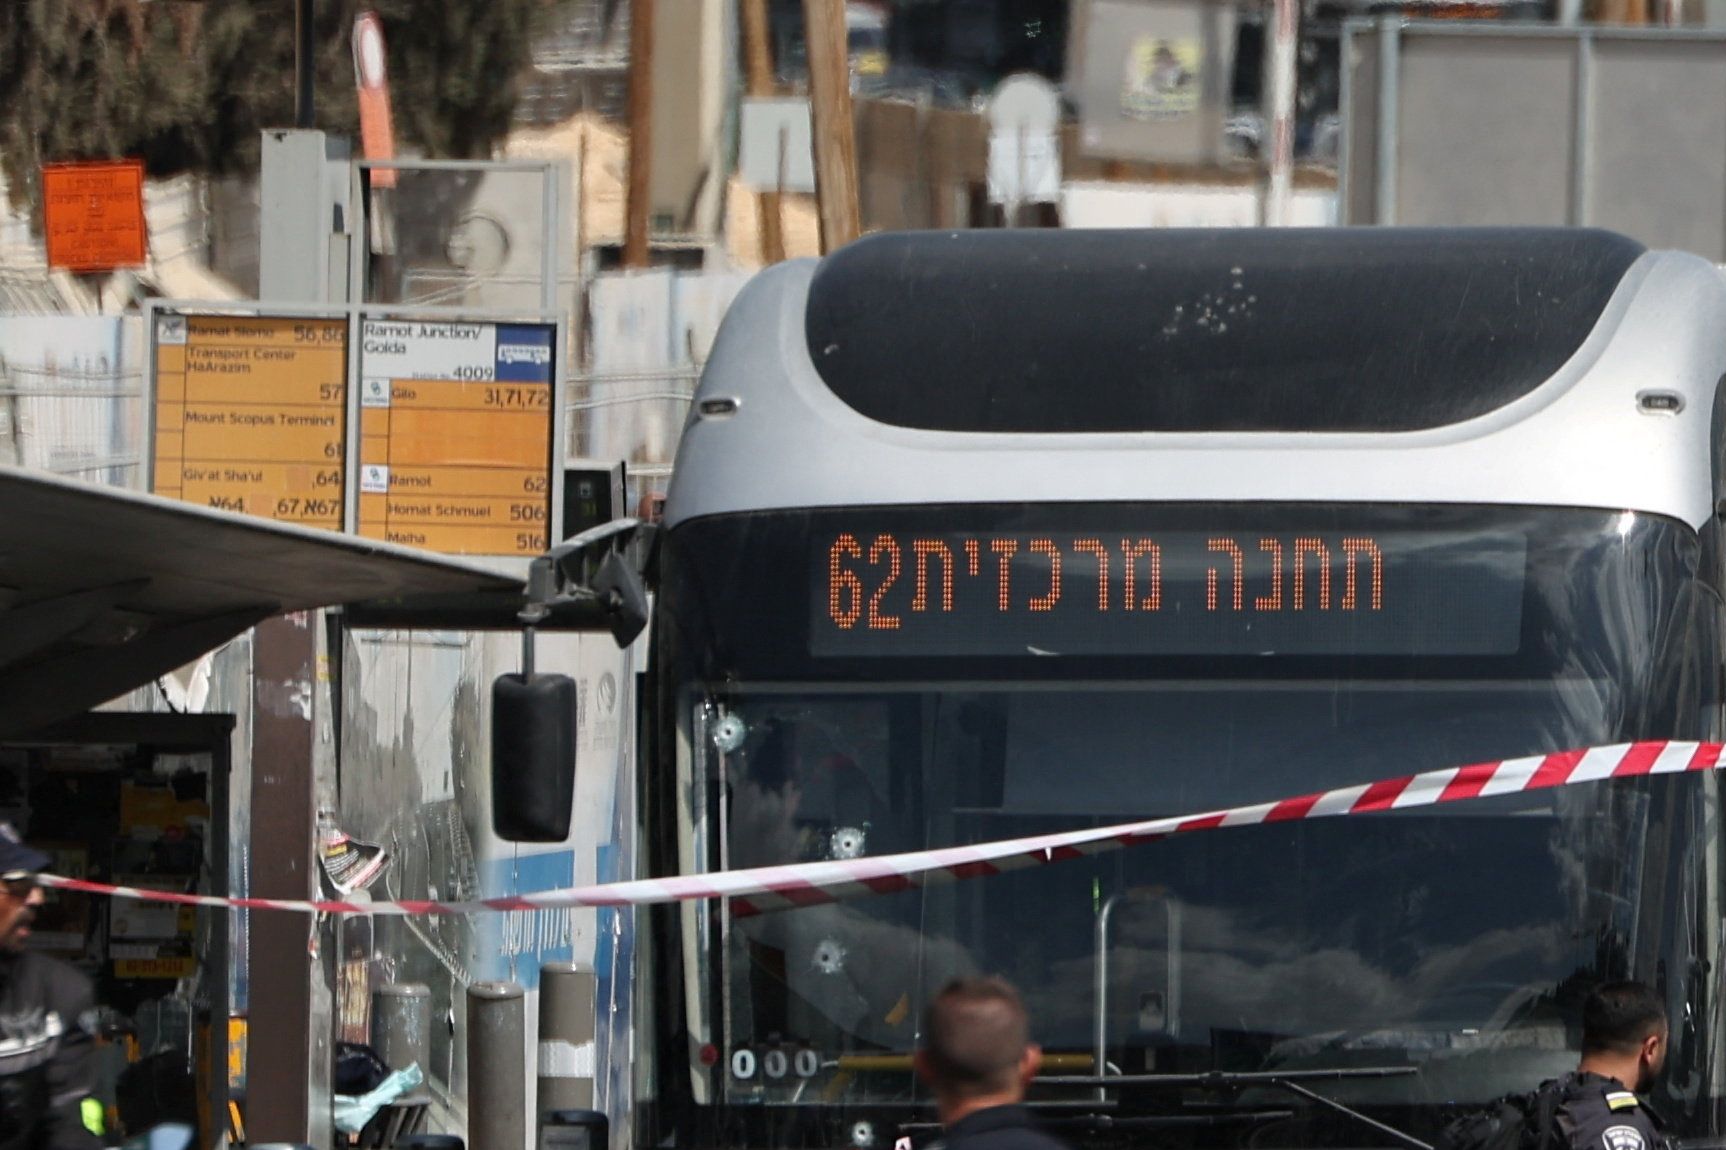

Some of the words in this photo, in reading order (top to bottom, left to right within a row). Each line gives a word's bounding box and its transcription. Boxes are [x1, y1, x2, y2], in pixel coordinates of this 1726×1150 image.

[363, 323, 412, 339] Ramot
[416, 324, 483, 340] Junction/
[189, 348, 249, 361] Transport
[253, 349, 297, 361] Center
[363, 341, 407, 354] Golda
[187, 361, 251, 373] HaArazim
[452, 365, 494, 380] 4009
[319, 383, 344, 401] 57
[391, 387, 417, 400] Gilo
[484, 388, 550, 409] 31,71,72
[185, 411, 225, 424] Mount
[230, 412, 275, 427] Scopus
[182, 470, 220, 482] Giv'at
[225, 470, 263, 482] Sha'ul
[388, 475, 432, 488] Ramot
[523, 476, 546, 493] 62
[436, 506, 491, 518] Schmuel
[510, 504, 545, 522] 506
[516, 533, 545, 551] 516
[829, 533, 901, 630] 62
[912, 537, 1161, 612] מרכזית
[1205, 537, 1382, 612] תחנה
